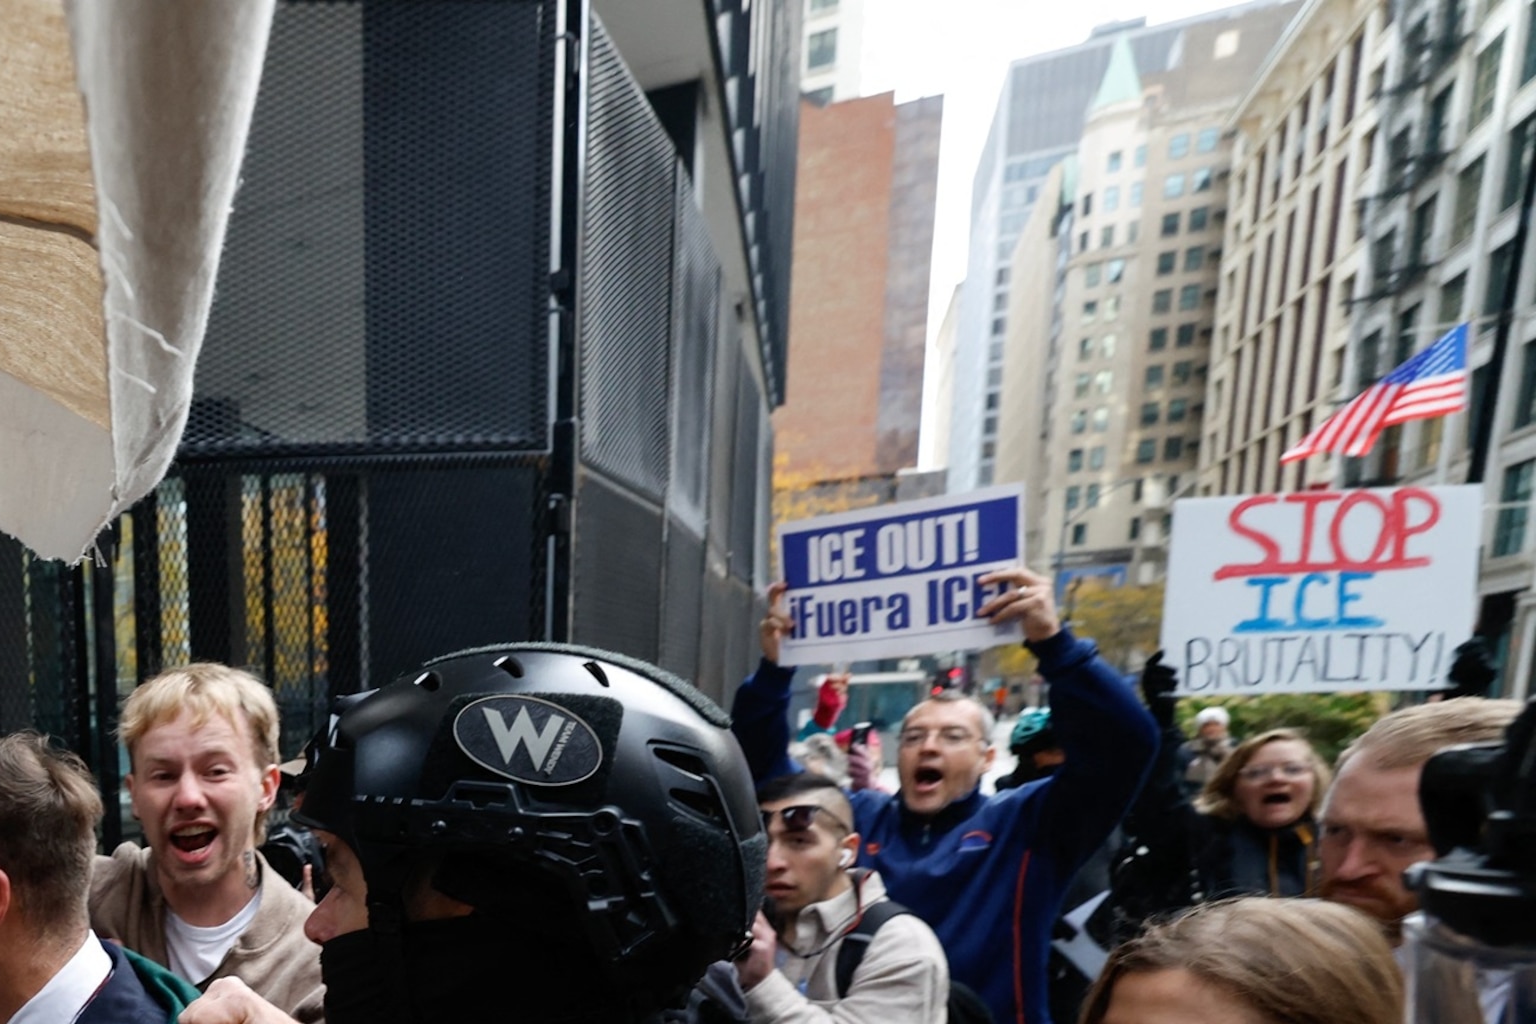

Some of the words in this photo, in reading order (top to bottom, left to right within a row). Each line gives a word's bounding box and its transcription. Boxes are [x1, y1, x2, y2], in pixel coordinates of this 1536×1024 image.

[807, 528, 866, 584] ICE
[876, 509, 979, 575] OUT!
[1213, 487, 1441, 581] STOP
[1233, 571, 1386, 632] ICE
[1183, 630, 1447, 692] BRUTALITY!
